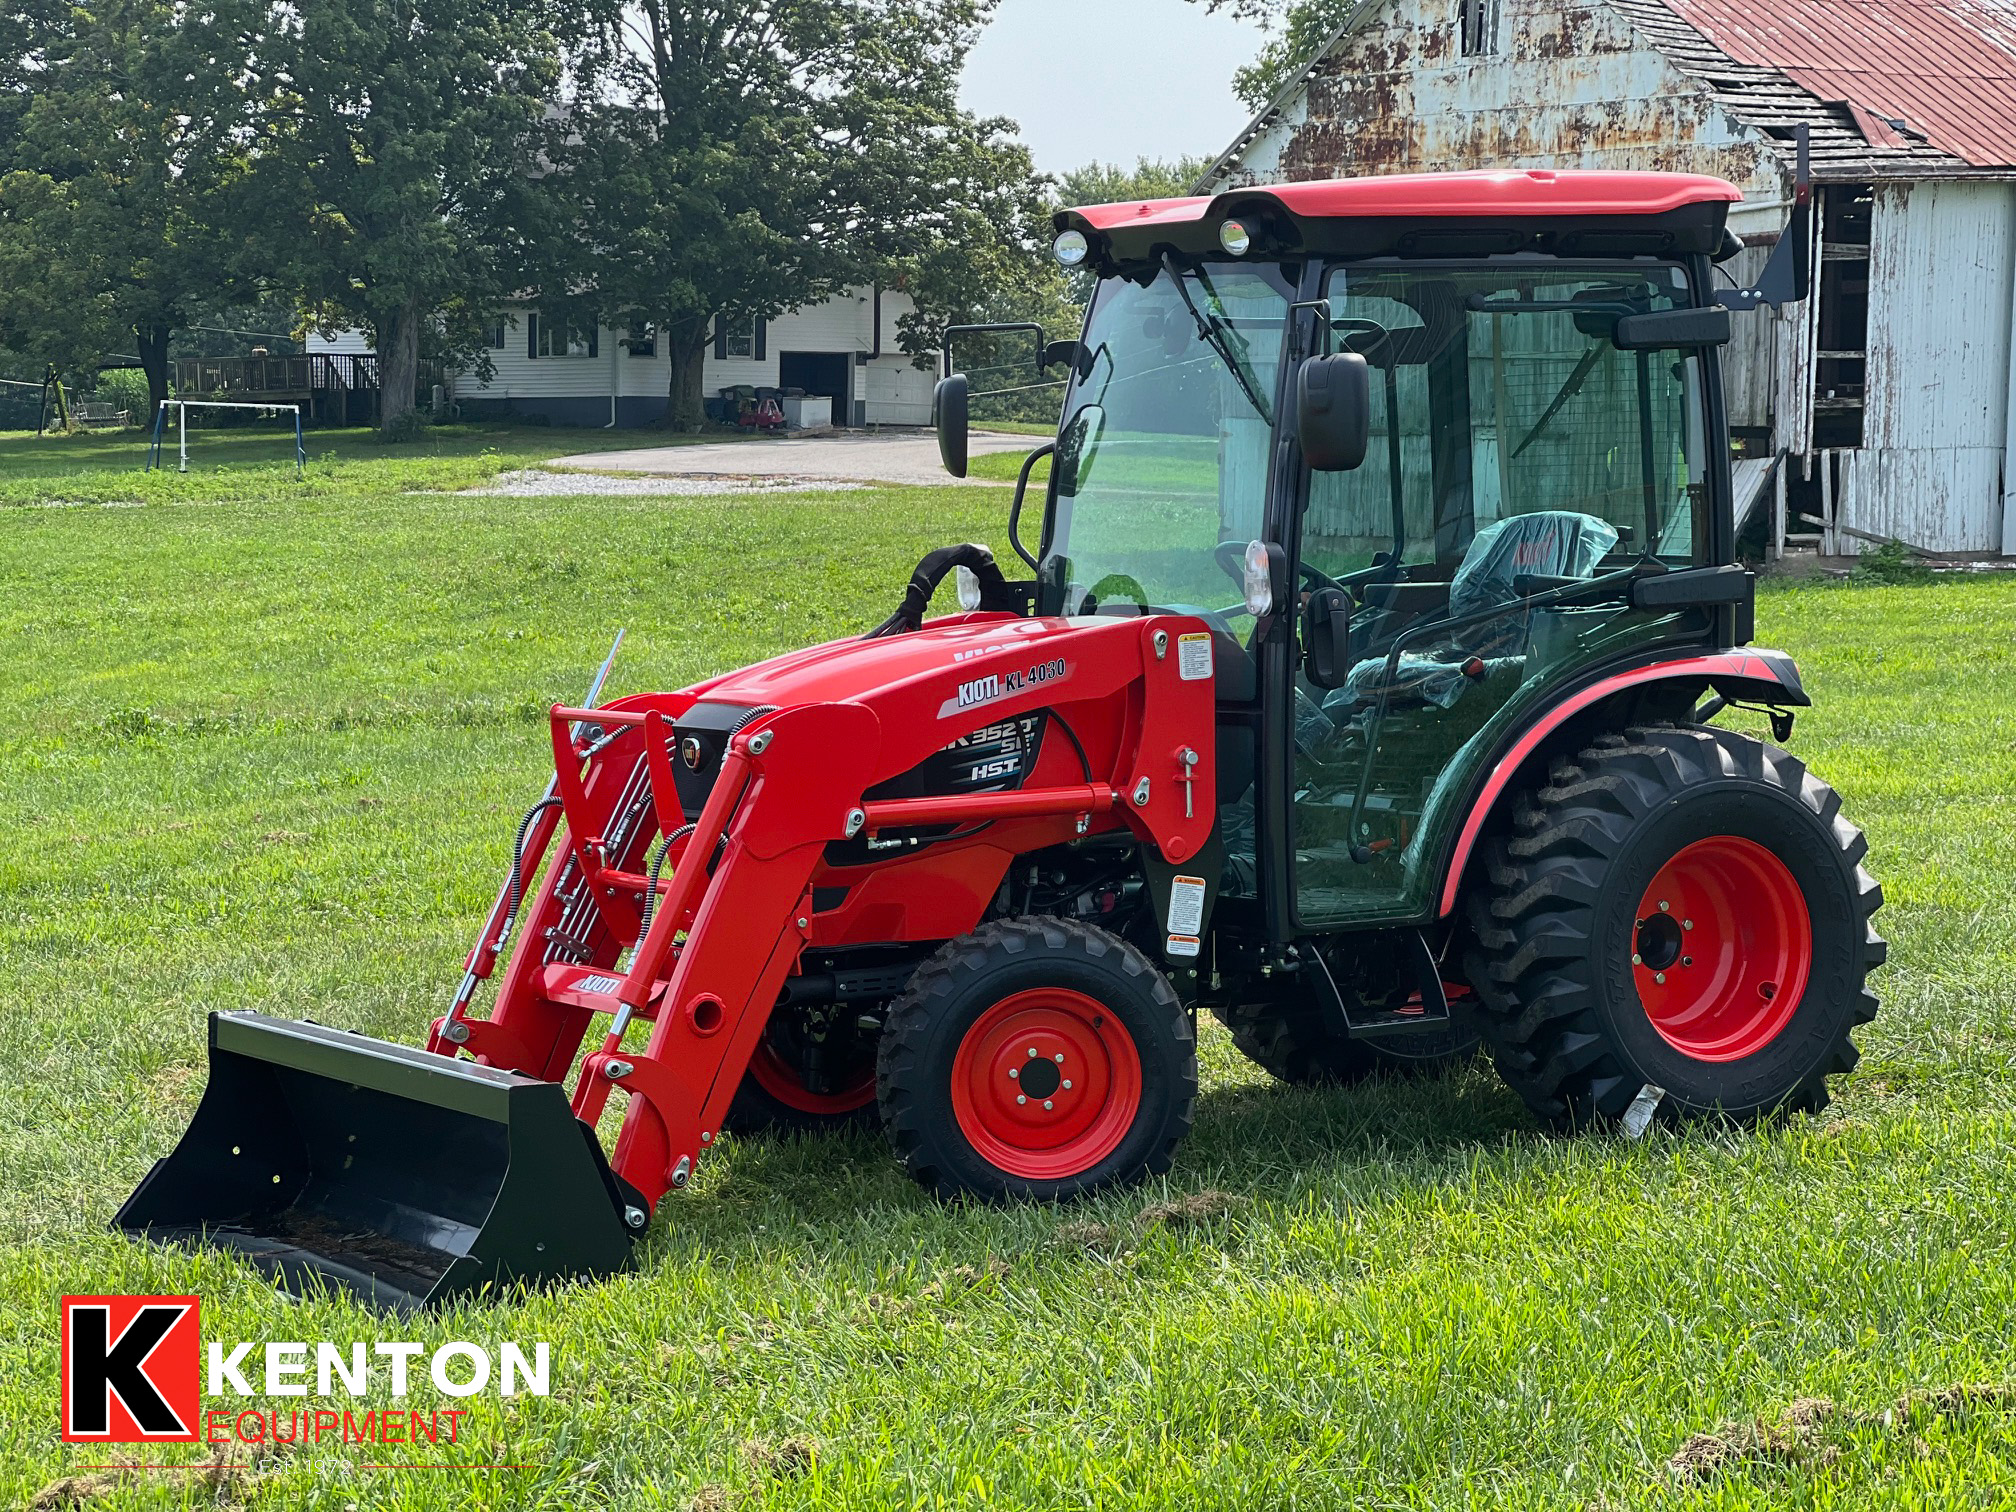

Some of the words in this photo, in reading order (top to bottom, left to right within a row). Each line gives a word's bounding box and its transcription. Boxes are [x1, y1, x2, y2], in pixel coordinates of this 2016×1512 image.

[957, 673, 1000, 707] KIOTI
[1005, 670, 1025, 693] KL
[1027, 658, 1066, 685] 4030
[971, 758, 1019, 781] HST
[579, 974, 621, 995] KIOTI
